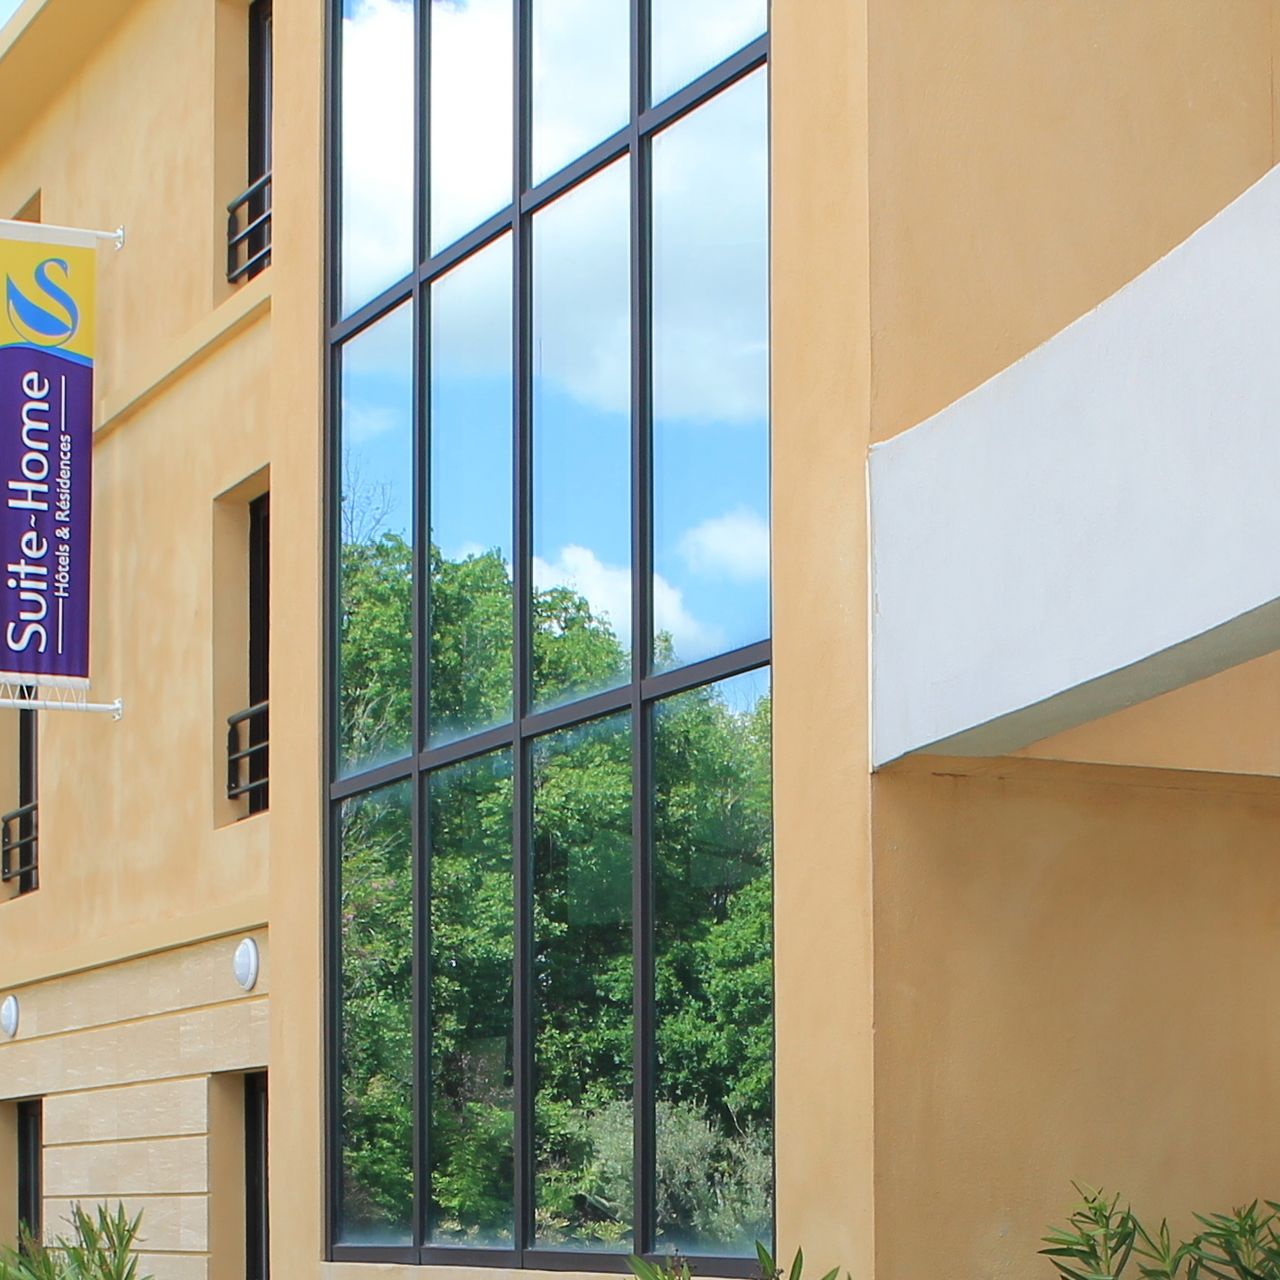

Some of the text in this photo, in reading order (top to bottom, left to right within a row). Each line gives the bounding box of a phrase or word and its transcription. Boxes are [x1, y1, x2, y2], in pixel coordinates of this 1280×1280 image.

[54, 434, 71, 598] Hôtels & Résidences
